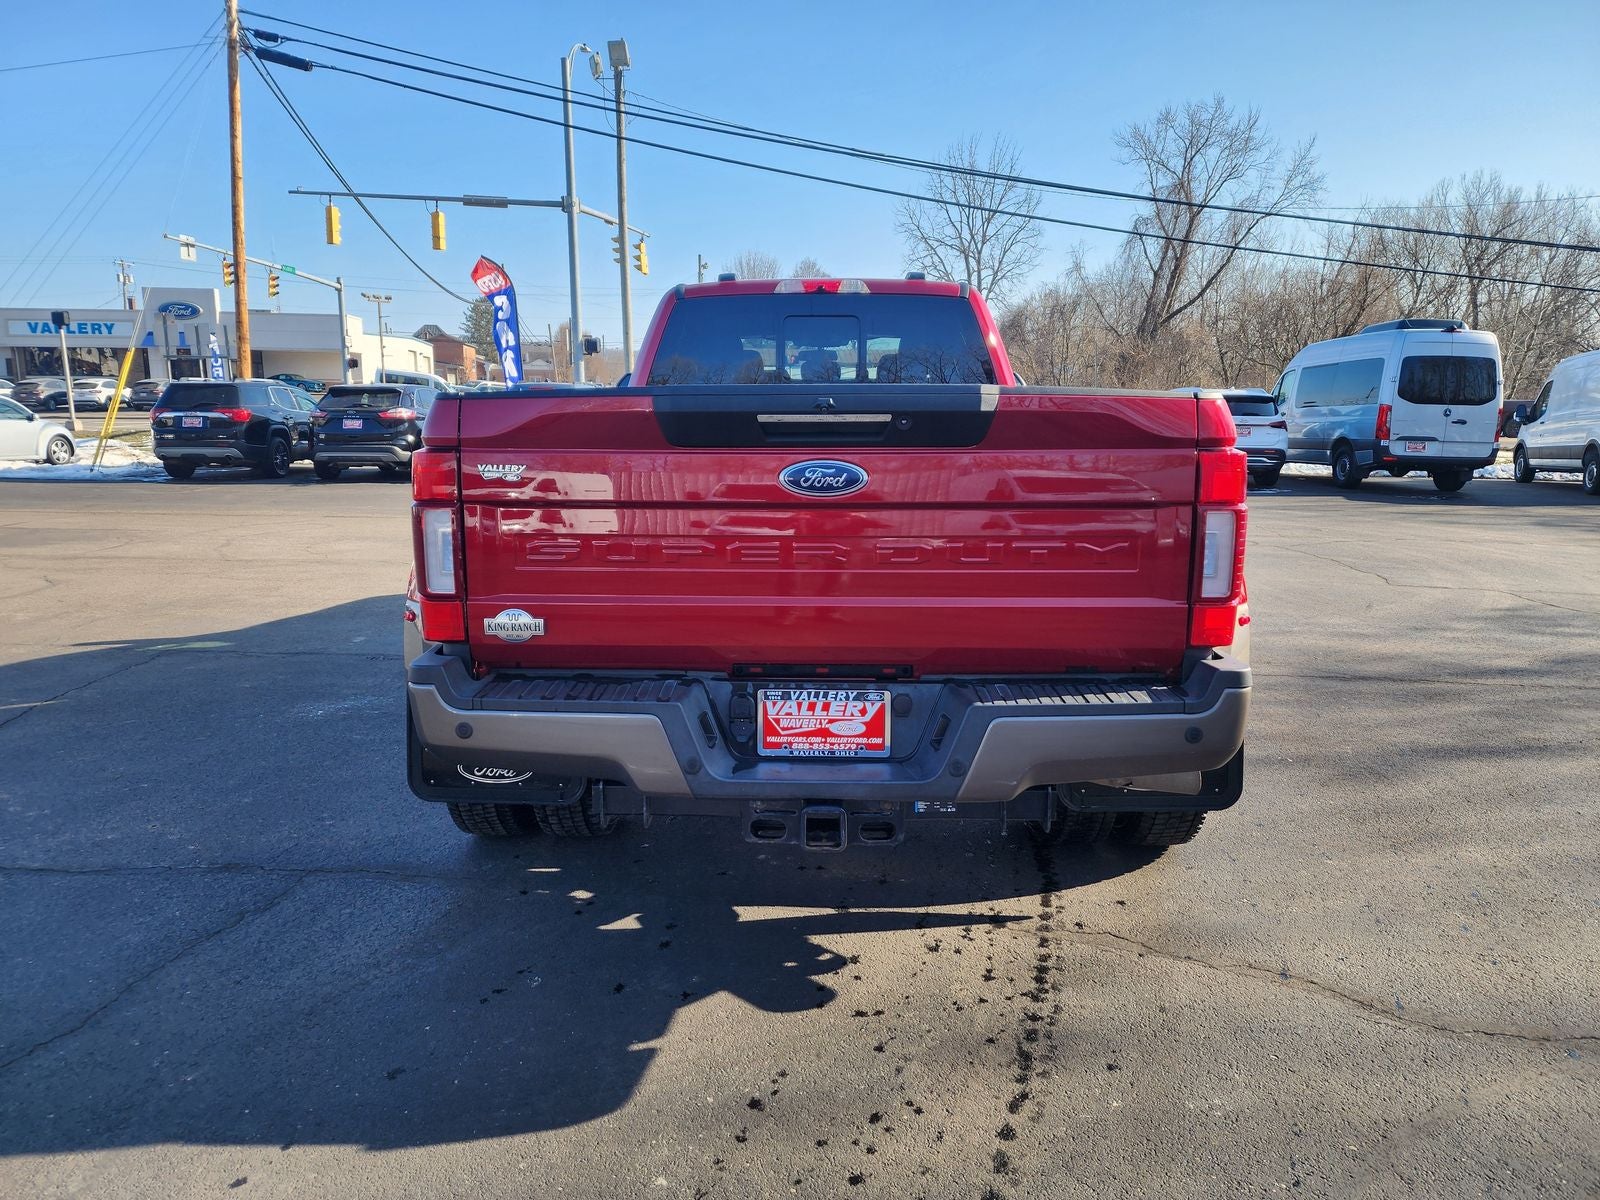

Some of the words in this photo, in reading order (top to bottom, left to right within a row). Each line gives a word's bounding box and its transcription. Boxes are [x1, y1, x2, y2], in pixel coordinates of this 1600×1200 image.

[166, 305, 192, 316] Ford
[477, 464, 527, 474] VALLERY
[800, 467, 847, 487] Ford
[526, 540, 850, 564] SUPER
[876, 538, 1130, 564] DUTY
[487, 621, 509, 632] KING
[511, 621, 542, 632] RANCH
[789, 691, 858, 701] VALLERY
[765, 700, 882, 721] VALLERY
